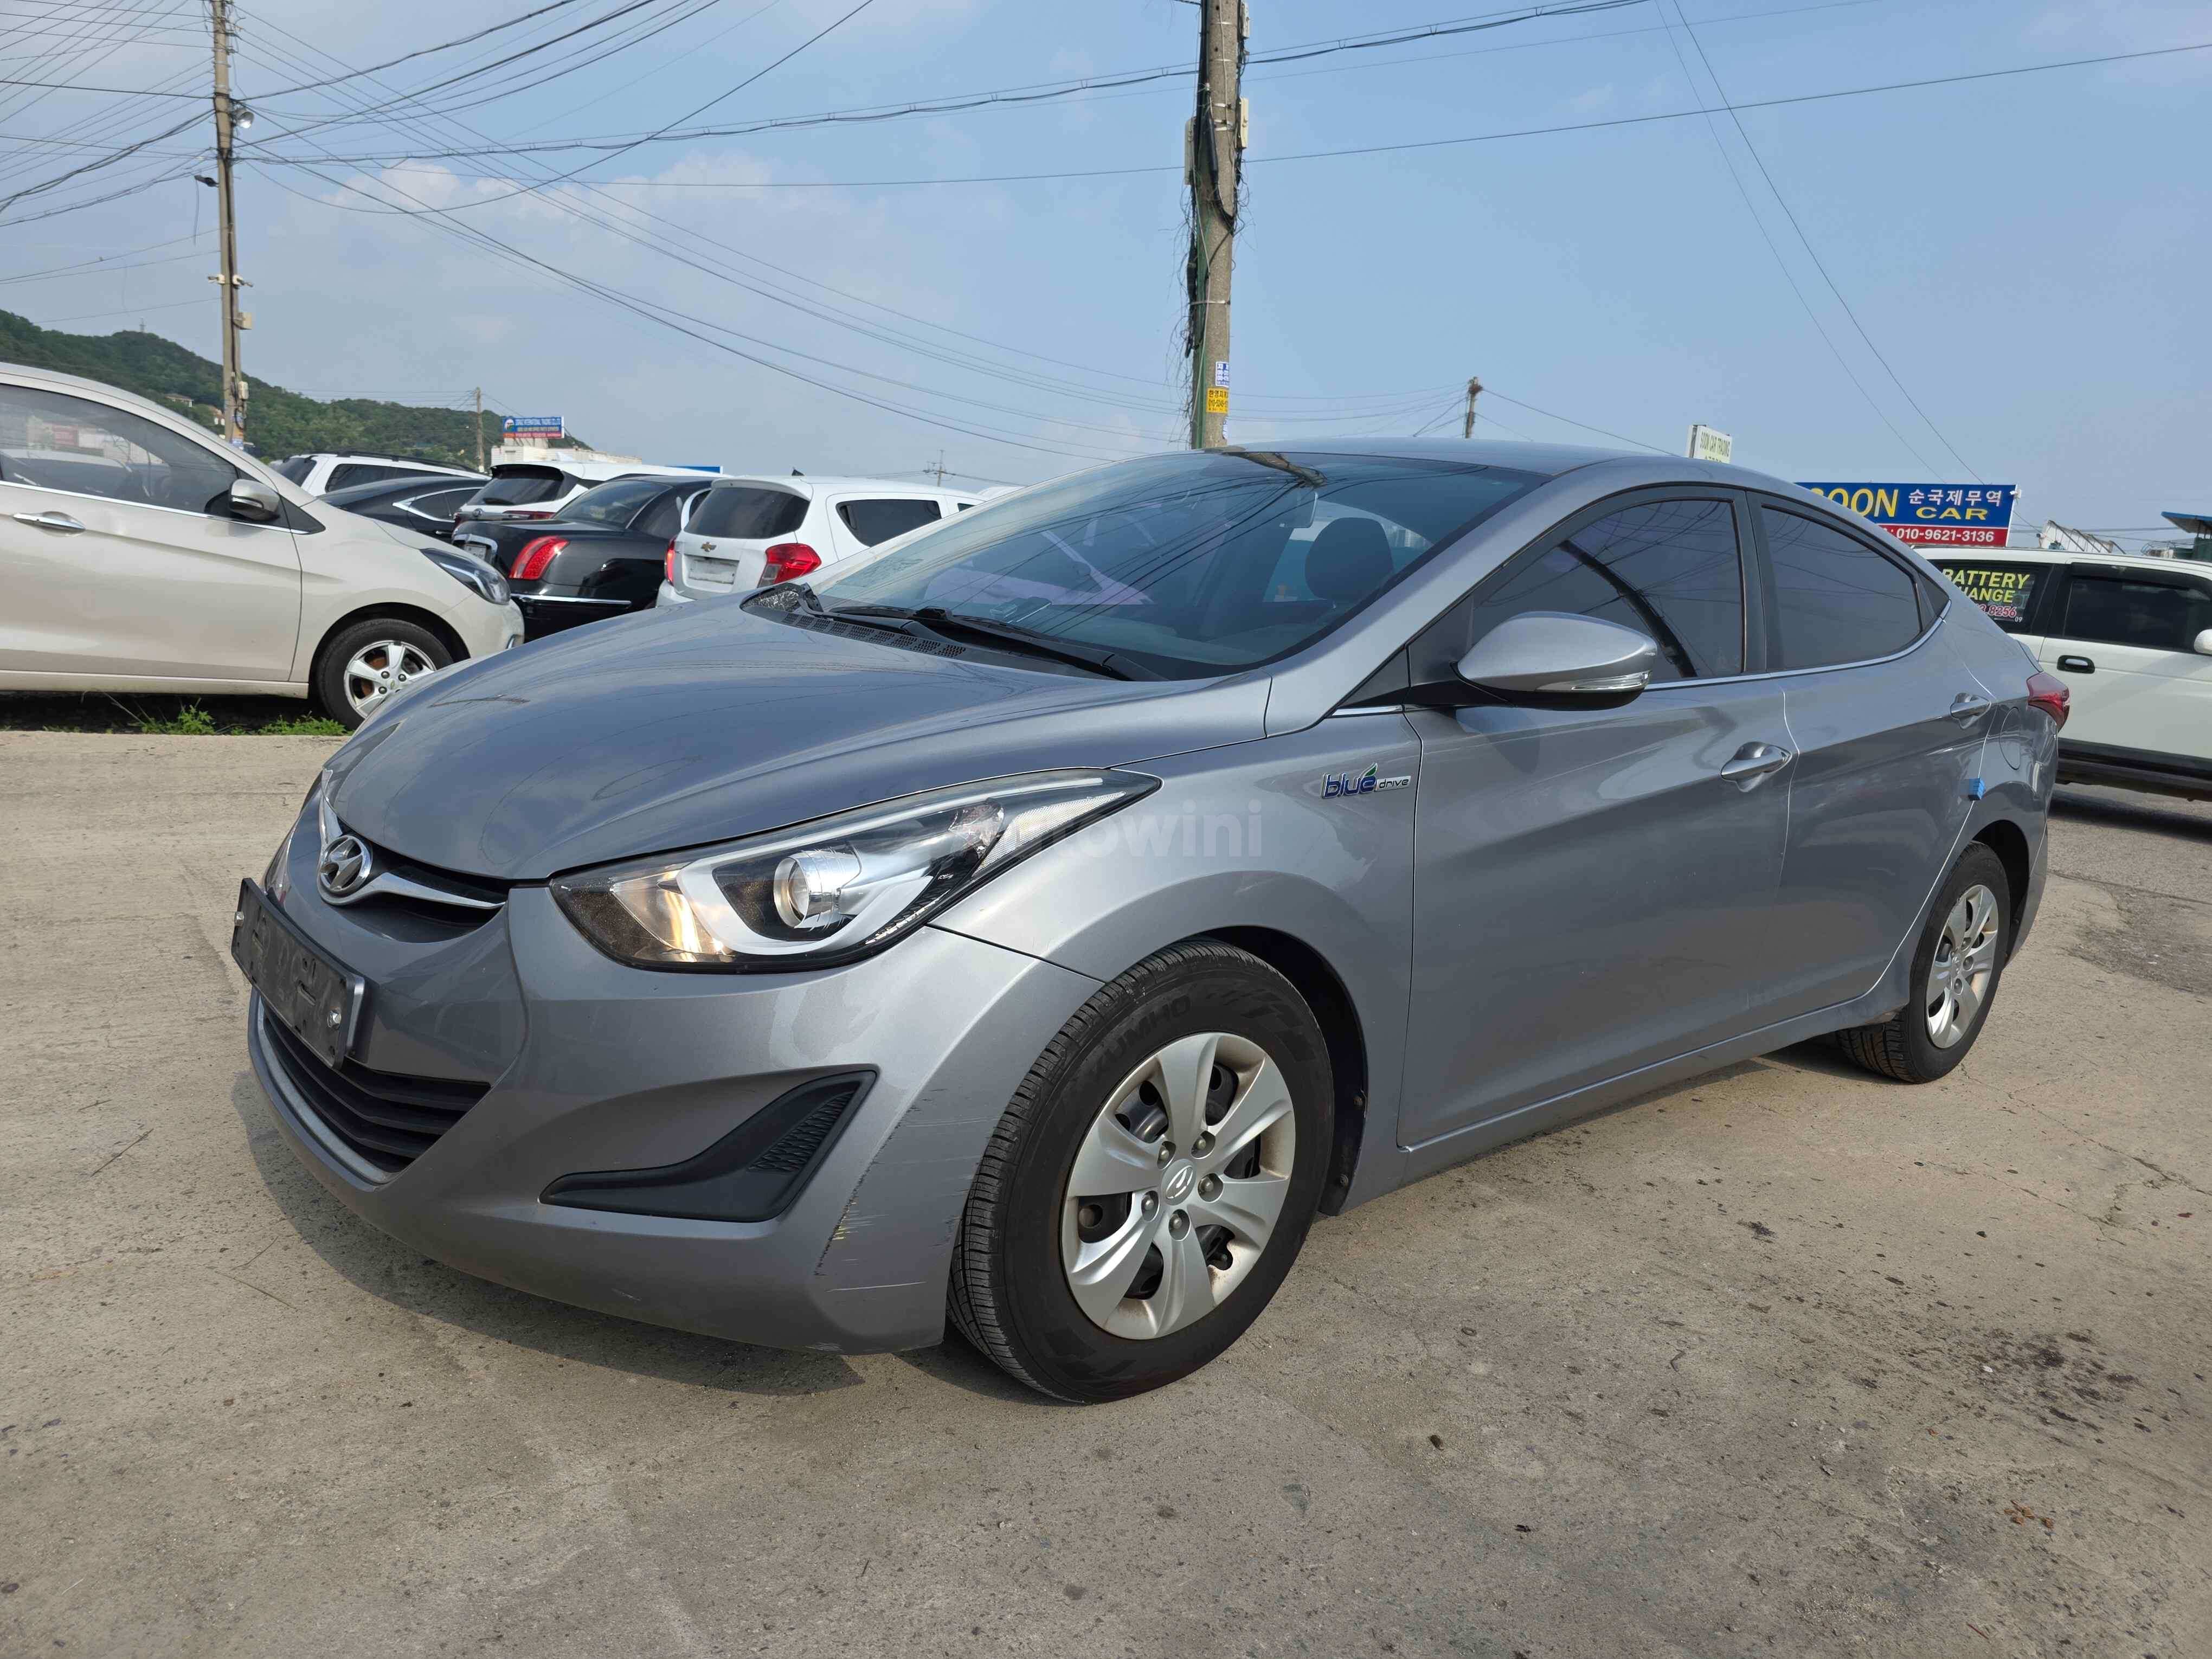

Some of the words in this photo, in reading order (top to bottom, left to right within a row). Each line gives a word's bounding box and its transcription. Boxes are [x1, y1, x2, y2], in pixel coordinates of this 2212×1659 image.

[1810, 488, 1899, 517] OON
[1908, 489, 2002, 506] 순국제무역
[1916, 507, 1988, 520] CAR
[1896, 528, 1994, 542] 010-9621-3136
[1322, 772, 1377, 798] blue
[1379, 778, 1409, 789] drive
